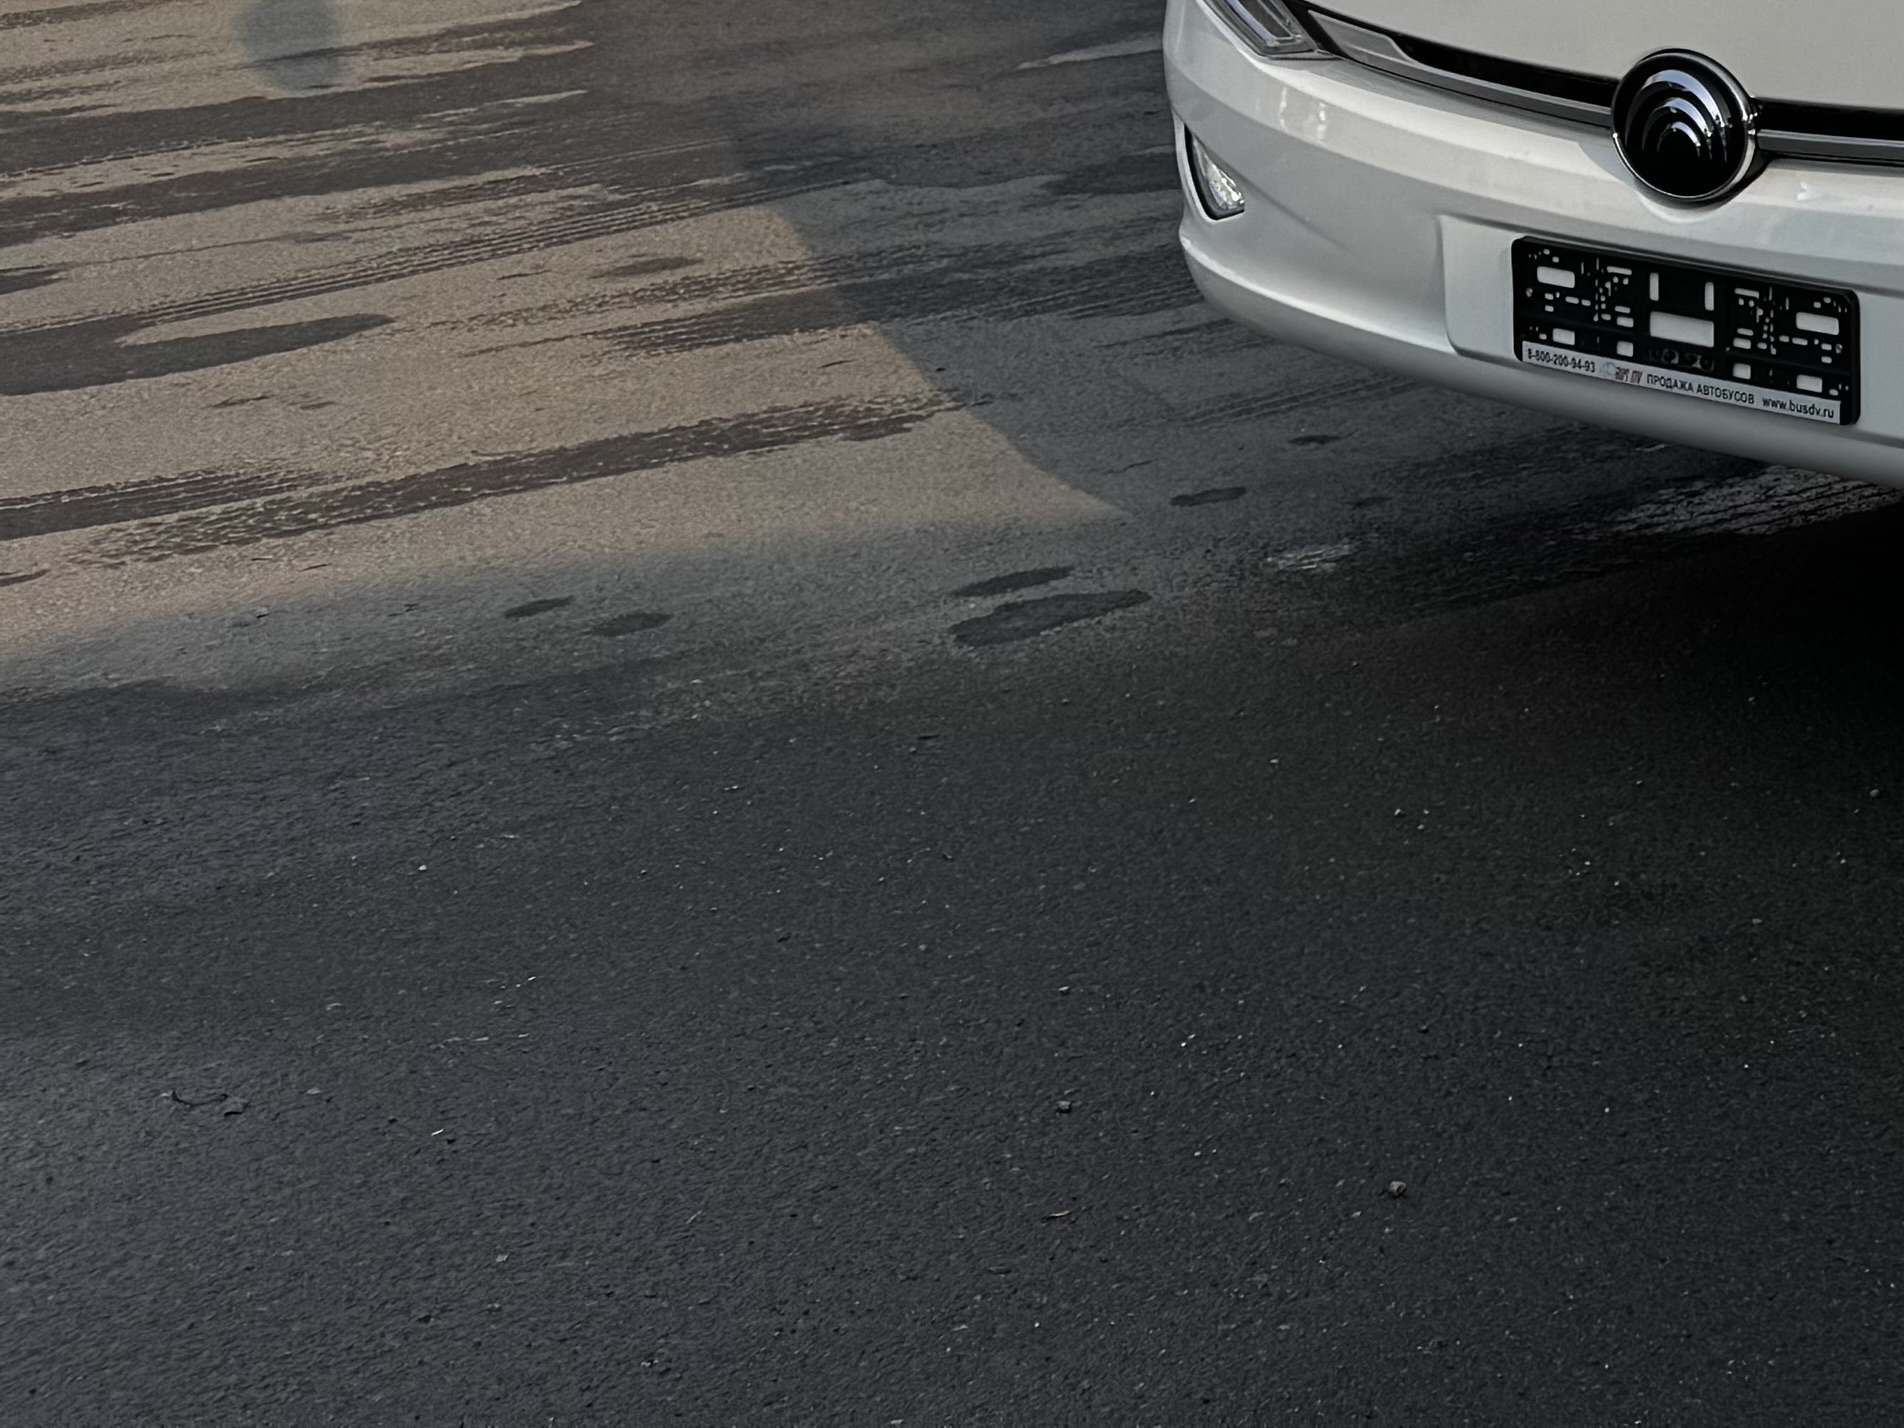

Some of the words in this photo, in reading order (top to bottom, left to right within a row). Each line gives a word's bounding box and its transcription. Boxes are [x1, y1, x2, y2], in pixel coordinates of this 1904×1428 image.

[1646, 373, 1694, 393] ПРОДАЖА
[1696, 383, 1755, 405] АВТОБУСОВ
[1762, 396, 1835, 419] www.busdv.ru
